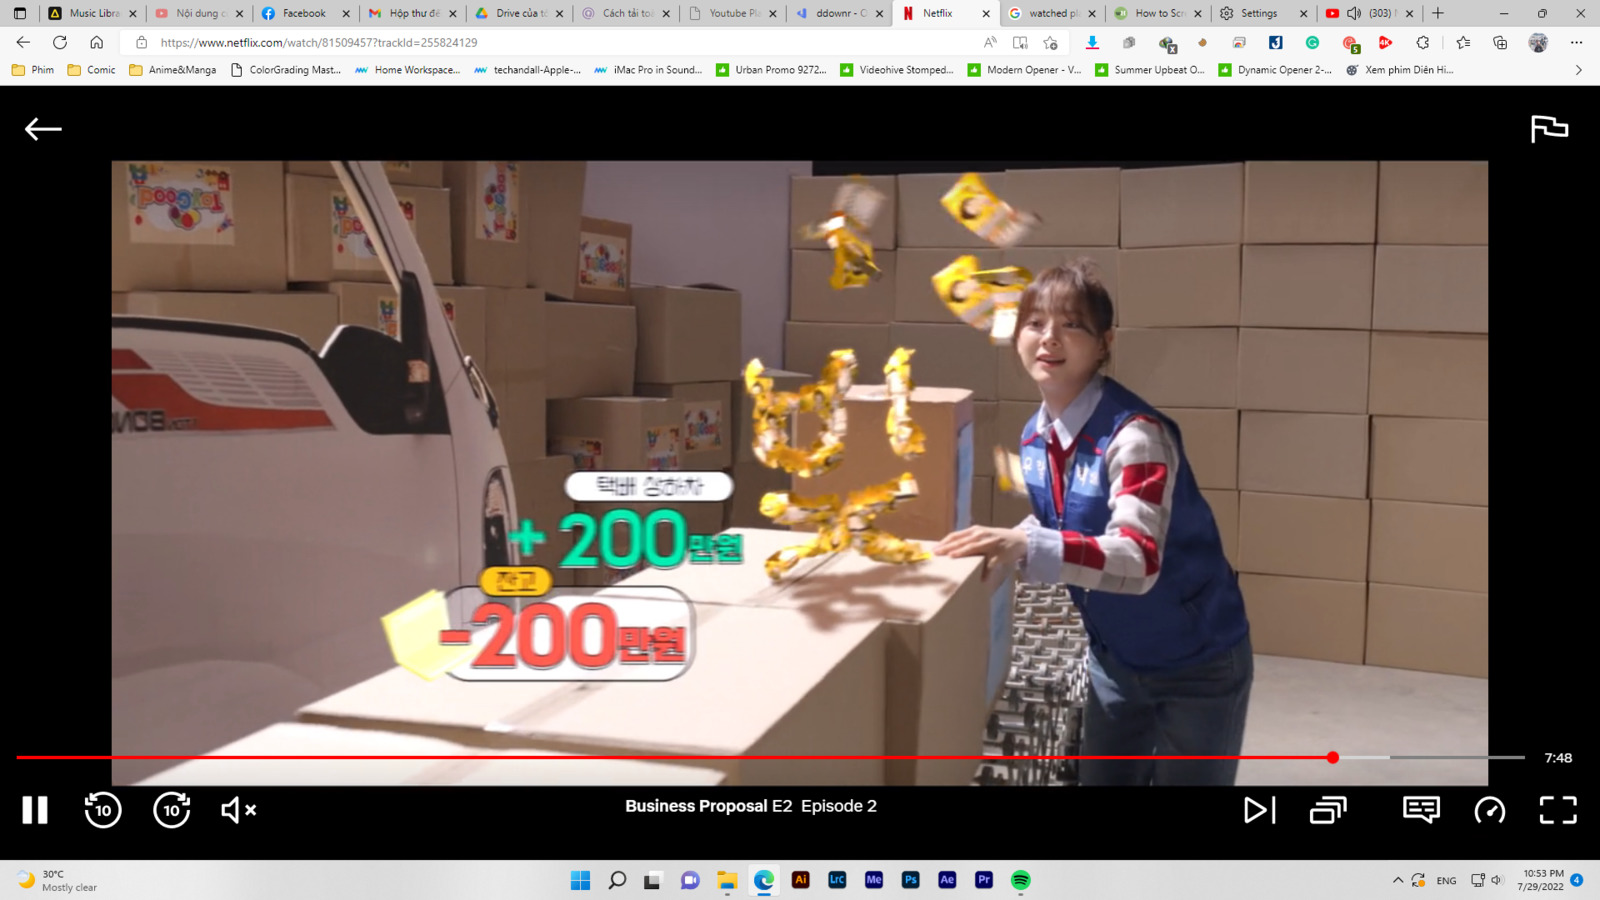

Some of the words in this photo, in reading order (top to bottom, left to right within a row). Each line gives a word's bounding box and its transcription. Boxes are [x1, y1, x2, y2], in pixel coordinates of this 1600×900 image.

[70, 8, 97, 18] Music
[177, 8, 193, 20] Nội
[195, 8, 218, 21] dung
[283, 8, 326, 18] Facebook
[390, 8, 409, 21] Hộp
[412, 8, 428, 18] thư
[497, 8, 520, 18] Drive
[522, 7, 539, 18] của
[602, 8, 625, 18] Cách
[628, 7, 639, 18] tải
[710, 8, 747, 18] Youtube
[816, 8, 851, 18] ddownr
[923, 8, 953, 18] Netflix
[1030, 8, 1067, 18] watched
[1136, 8, 1156, 18] How
[1159, 9, 1168, 18] to
[1241, 8, 1278, 21] Settings
[1369, 8, 1392, 19] (303)
[160, 36, 478, 49] https://www.netflix.com/watch/81509457?trackId=255824129
[32, 64, 54, 75] Phim
[87, 64, 115, 75] Comic
[149, 64, 217, 77] Anime&Manga
[250, 64, 309, 77] ColorGrading
[312, 64, 341, 75] Mast...
[375, 64, 403, 75] Home
[404, 64, 461, 77] Workspace...
[494, 64, 581, 77] techandall-Apple-...
[614, 64, 635, 75] iMac
[638, 64, 653, 75] Pro
[656, 64, 664, 75] in
[667, 64, 702, 75] Sound...
[736, 64, 763, 75] Urban
[766, 64, 795, 75] Promo
[798, 64, 826, 75] 9272...
[860, 64, 904, 75] Videohive
[906, 64, 954, 77] Stomped...
[988, 64, 1023, 75] Modern
[1025, 64, 1059, 77] Opener
[1067, 65, 1082, 75] V...
[1115, 64, 1152, 75] Summer
[1155, 64, 1187, 77] Upbeat
[1190, 64, 1204, 75] O...
[1239, 64, 1277, 77] Dynamic
[1279, 64, 1313, 77] Opener
[1366, 64, 1386, 75] Xem
[1388, 64, 1411, 77] phim
[1437, 64, 1454, 75] Hi...
[1544, 752, 1573, 764] 7:48
[95, 805, 112, 817] 10
[163, 805, 180, 817] 10
[625, 798, 696, 813] Business
[699, 798, 768, 816] Proposal
[772, 799, 793, 813] E2
[801, 798, 863, 816] Episode
[866, 799, 878, 813] 2
[43, 869, 64, 879] 30°C
[795, 874, 807, 884] Ai
[866, 874, 882, 884] Me
[905, 874, 918, 884] Ps
[940, 874, 955, 884] Ae
[978, 874, 991, 884] Pr
[1523, 869, 1547, 878] 10:53
[1549, 869, 1565, 878] PM
[1436, 876, 1457, 886] ENG
[42, 882, 73, 894] Mostly
[75, 882, 98, 892] clear
[1517, 882, 1565, 893] 7/29/2022
